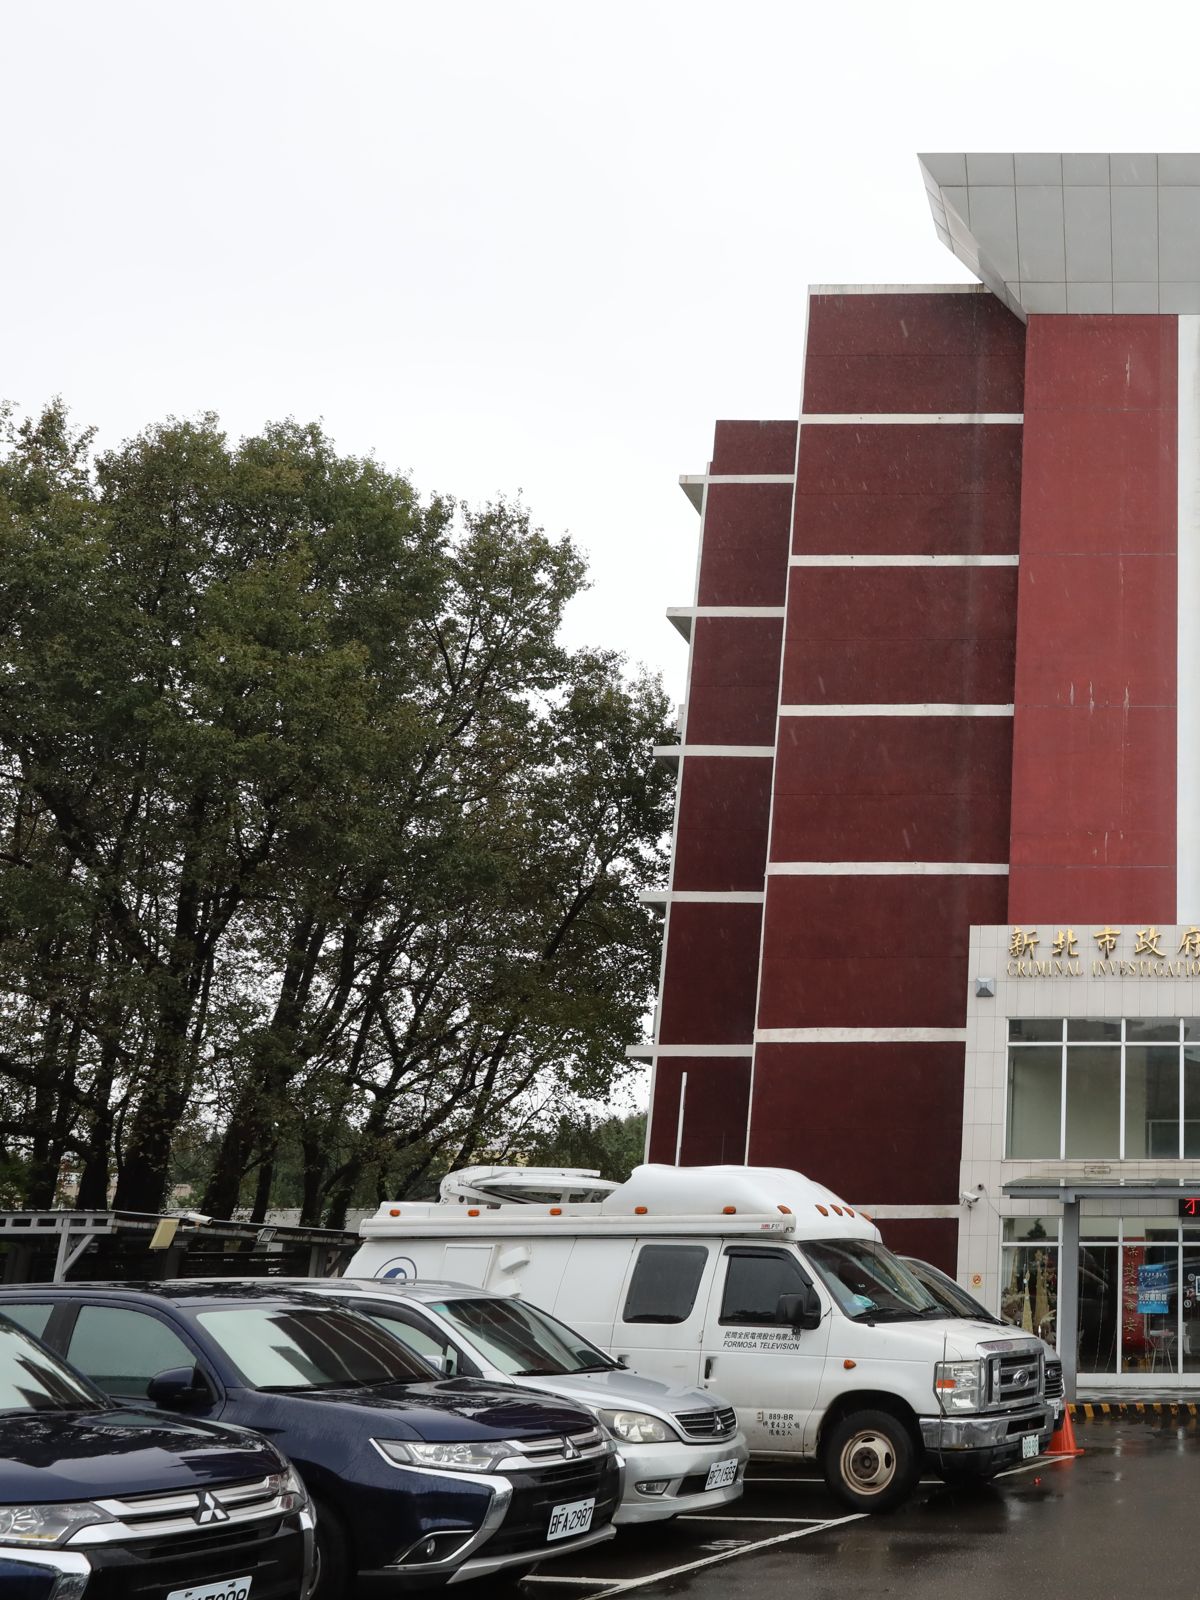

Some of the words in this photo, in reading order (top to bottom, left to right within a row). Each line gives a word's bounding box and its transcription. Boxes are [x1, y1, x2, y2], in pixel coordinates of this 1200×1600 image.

[1007, 959, 1083, 977] CRIMINAL
[723, 1340, 757, 1349] FORMOSA
[760, 1341, 800, 1351] TELEVISION
[768, 1413, 794, 1421] 889-BR
[549, 1506, 594, 1535] BFA-2987
